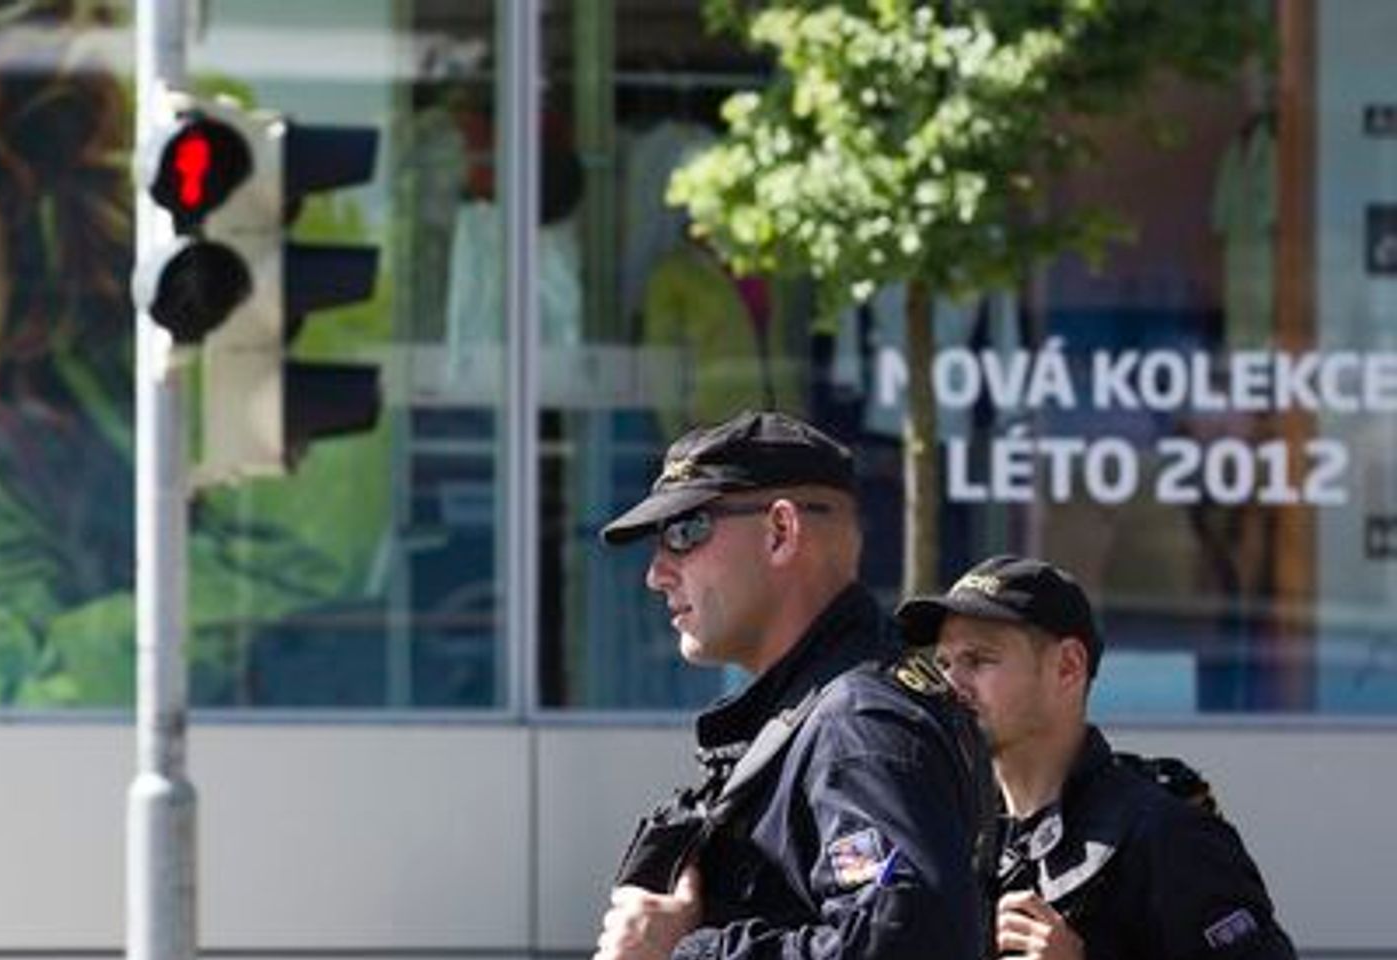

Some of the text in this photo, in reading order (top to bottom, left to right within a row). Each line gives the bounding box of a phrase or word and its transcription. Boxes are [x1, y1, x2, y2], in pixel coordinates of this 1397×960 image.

[1092, 349, 1397, 412] KOLEKCE
[947, 423, 1348, 505] LÉTO 2012
